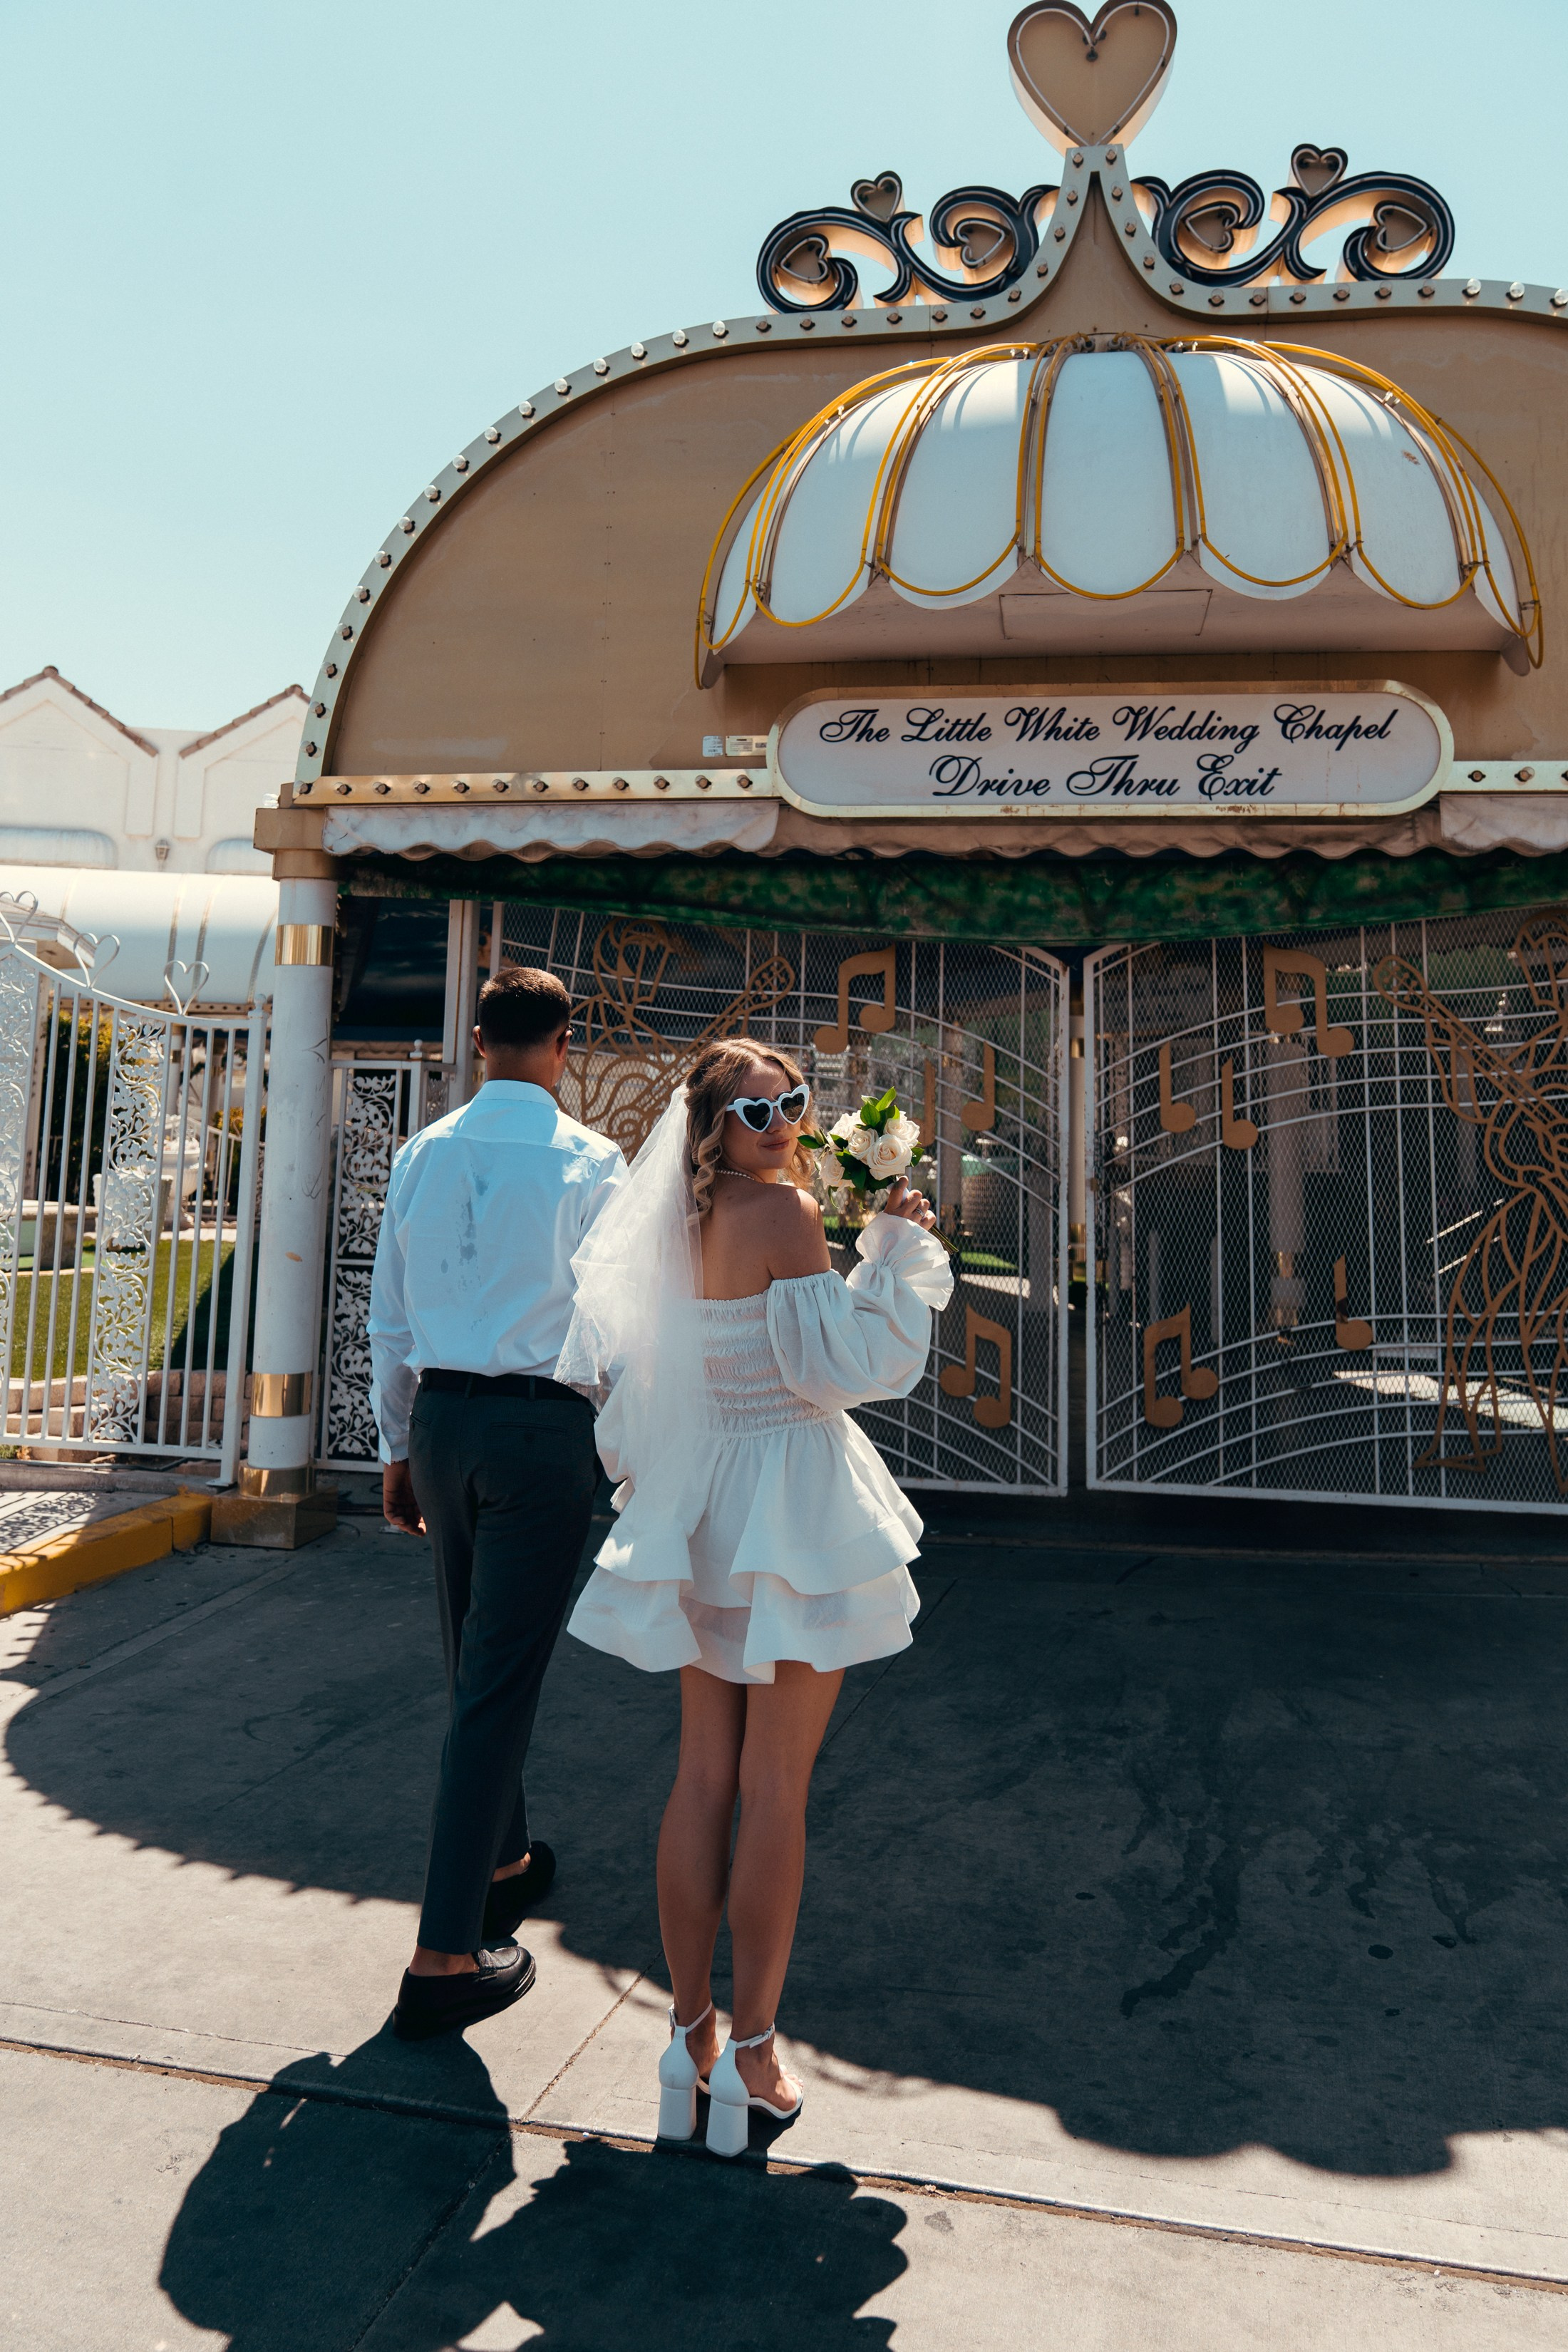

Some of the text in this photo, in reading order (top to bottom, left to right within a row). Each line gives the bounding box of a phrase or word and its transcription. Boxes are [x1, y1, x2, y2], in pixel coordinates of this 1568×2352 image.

[819, 703, 1399, 755] The Little White Wedding Chapel
[928, 753, 1283, 801] Drive Thru Exit
